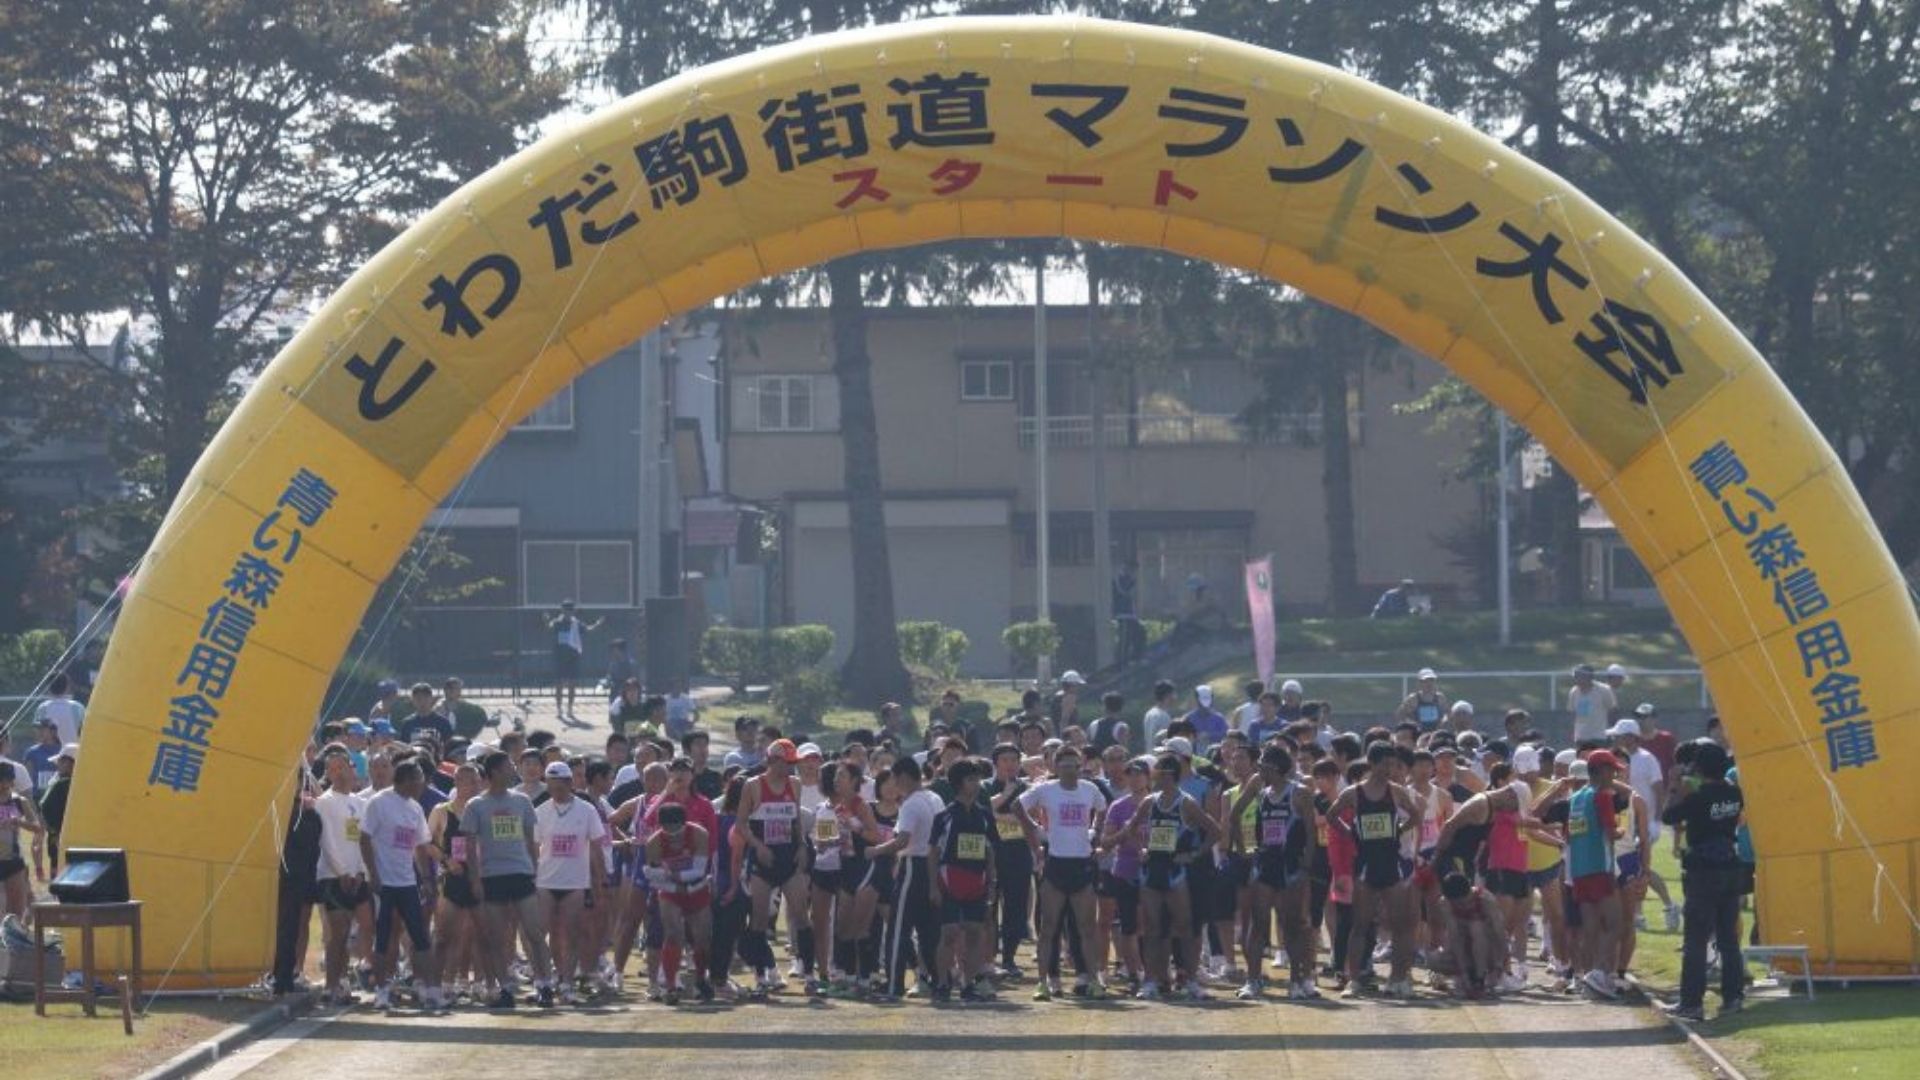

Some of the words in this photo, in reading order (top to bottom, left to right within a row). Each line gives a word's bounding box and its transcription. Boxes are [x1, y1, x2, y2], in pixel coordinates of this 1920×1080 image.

[344, 70, 1684, 421] とわだ駒街道マラソン大会
[833, 158, 1199, 210] スタート
[149, 468, 338, 792] 青い森信用金庫
[1688, 441, 1879, 771] 青い森信用金庫
